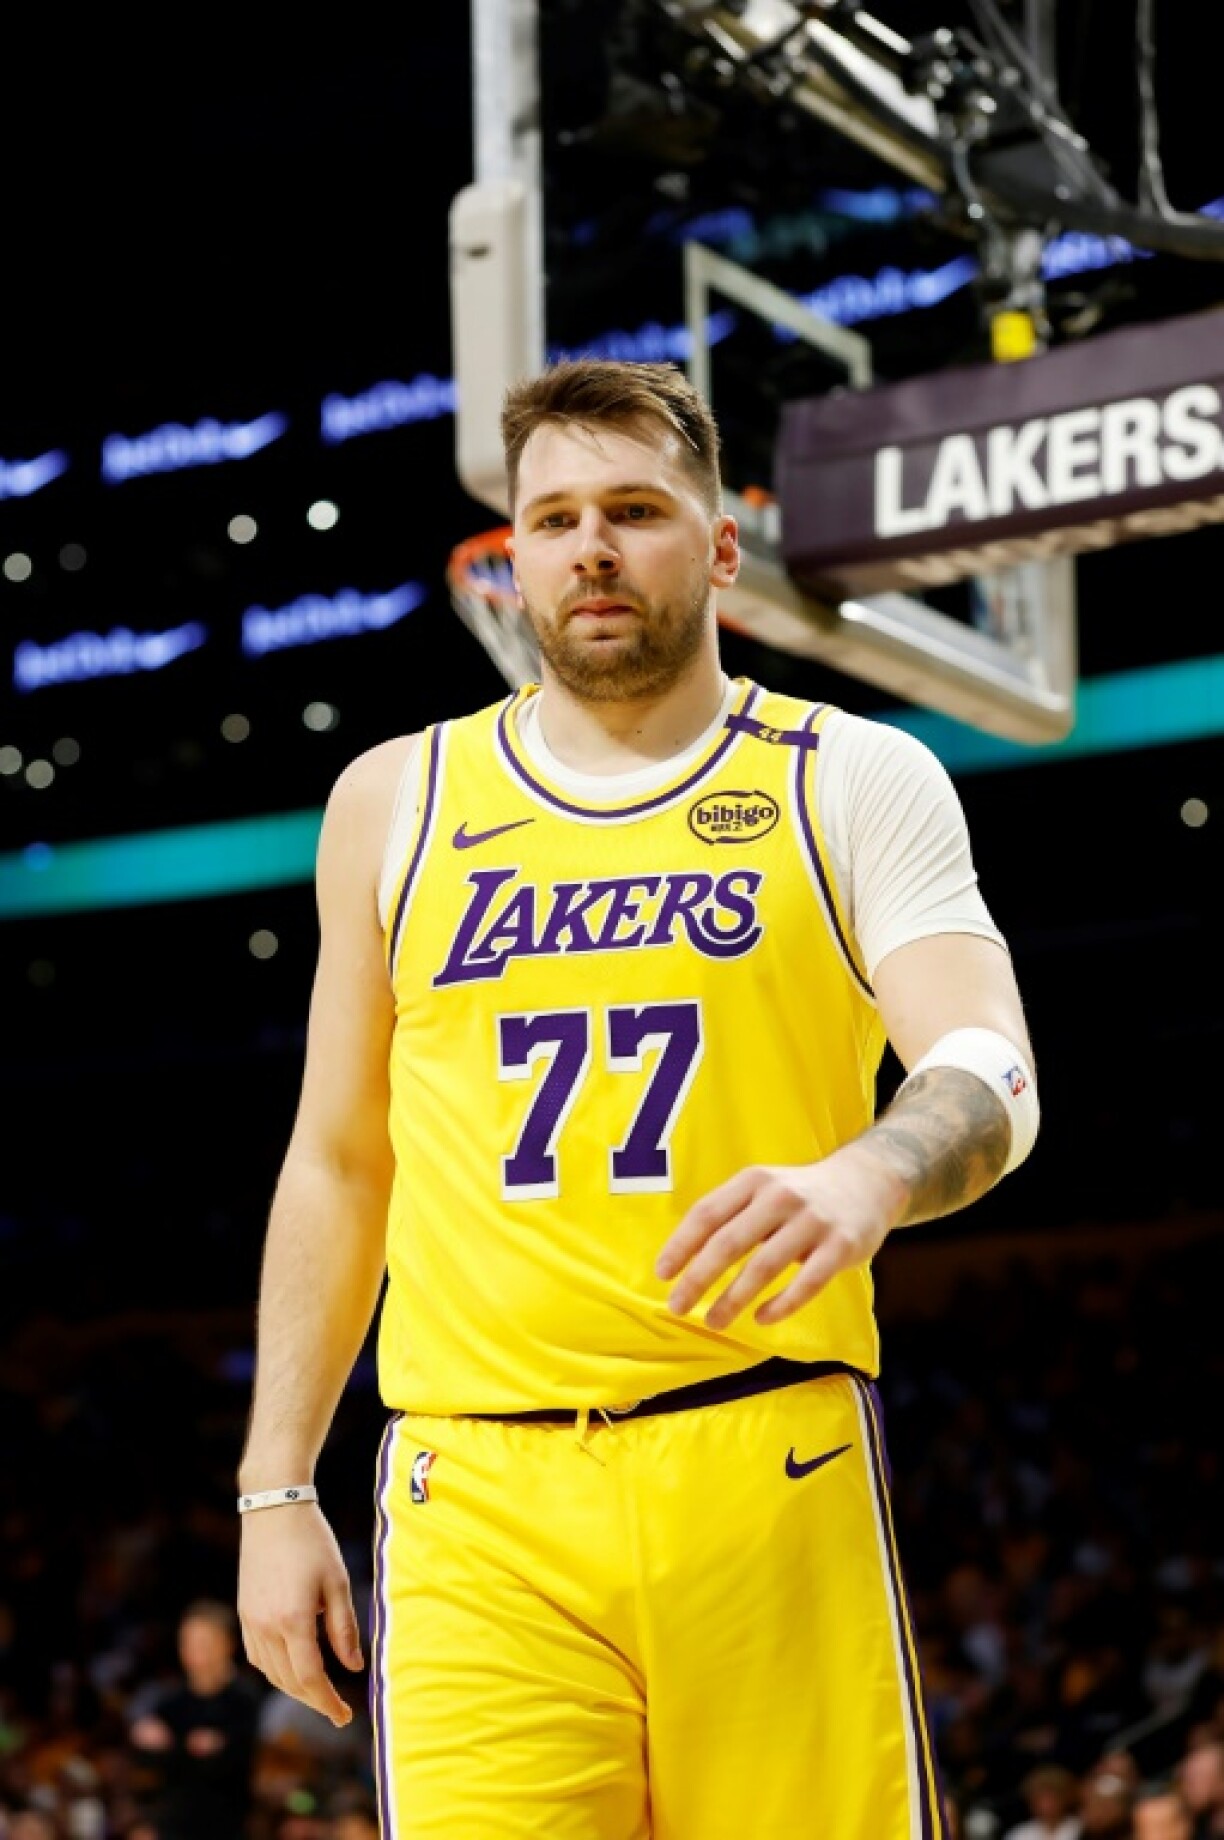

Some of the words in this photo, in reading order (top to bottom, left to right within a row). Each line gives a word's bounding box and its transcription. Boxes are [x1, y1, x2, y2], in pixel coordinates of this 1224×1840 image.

[873, 384, 1224, 539] LAKERS
[696, 803, 774, 827] bibigo
[433, 867, 763, 988] LAKERS
[497, 999, 704, 1201] 77
